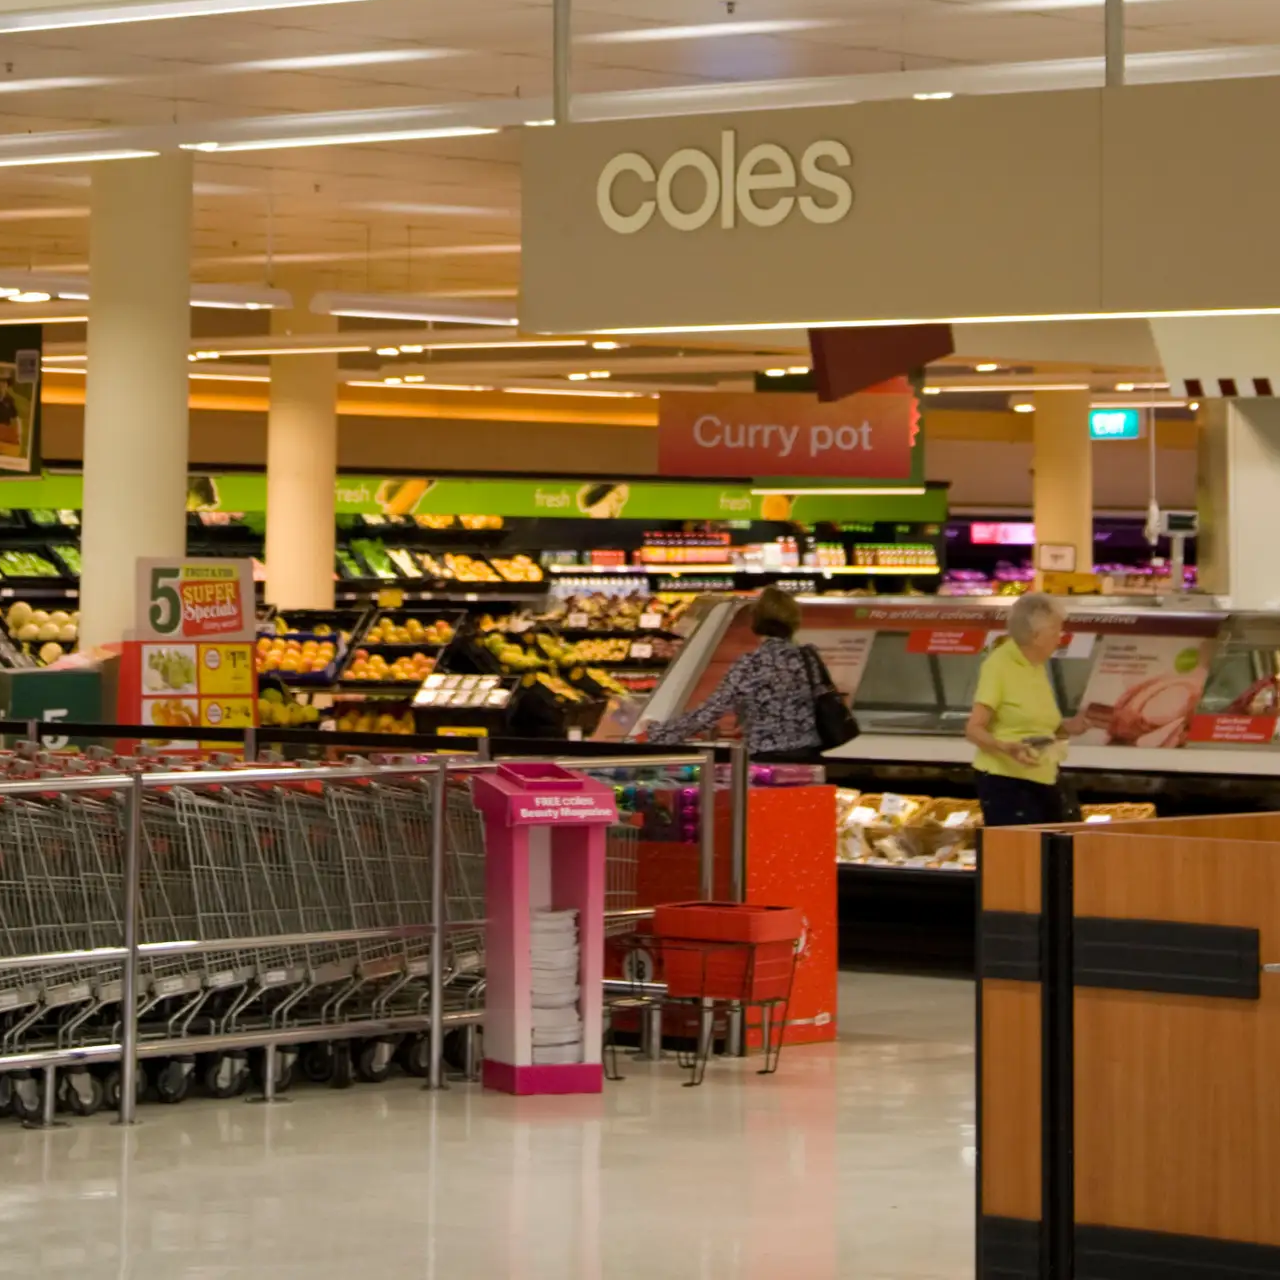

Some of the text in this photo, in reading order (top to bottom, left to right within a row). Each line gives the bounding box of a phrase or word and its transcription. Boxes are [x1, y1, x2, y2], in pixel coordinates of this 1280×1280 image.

[597, 128, 853, 234] coles
[693, 415, 873, 458] Curry pot
[535, 487, 570, 508] fresh
[720, 491, 752, 511] fresh
[149, 567, 181, 633] 5
[183, 582, 236, 604] SUPER
[183, 597, 238, 623] Specials
[520, 807, 613, 819] Beauty Magazine
[534, 797, 561, 807] FREE
